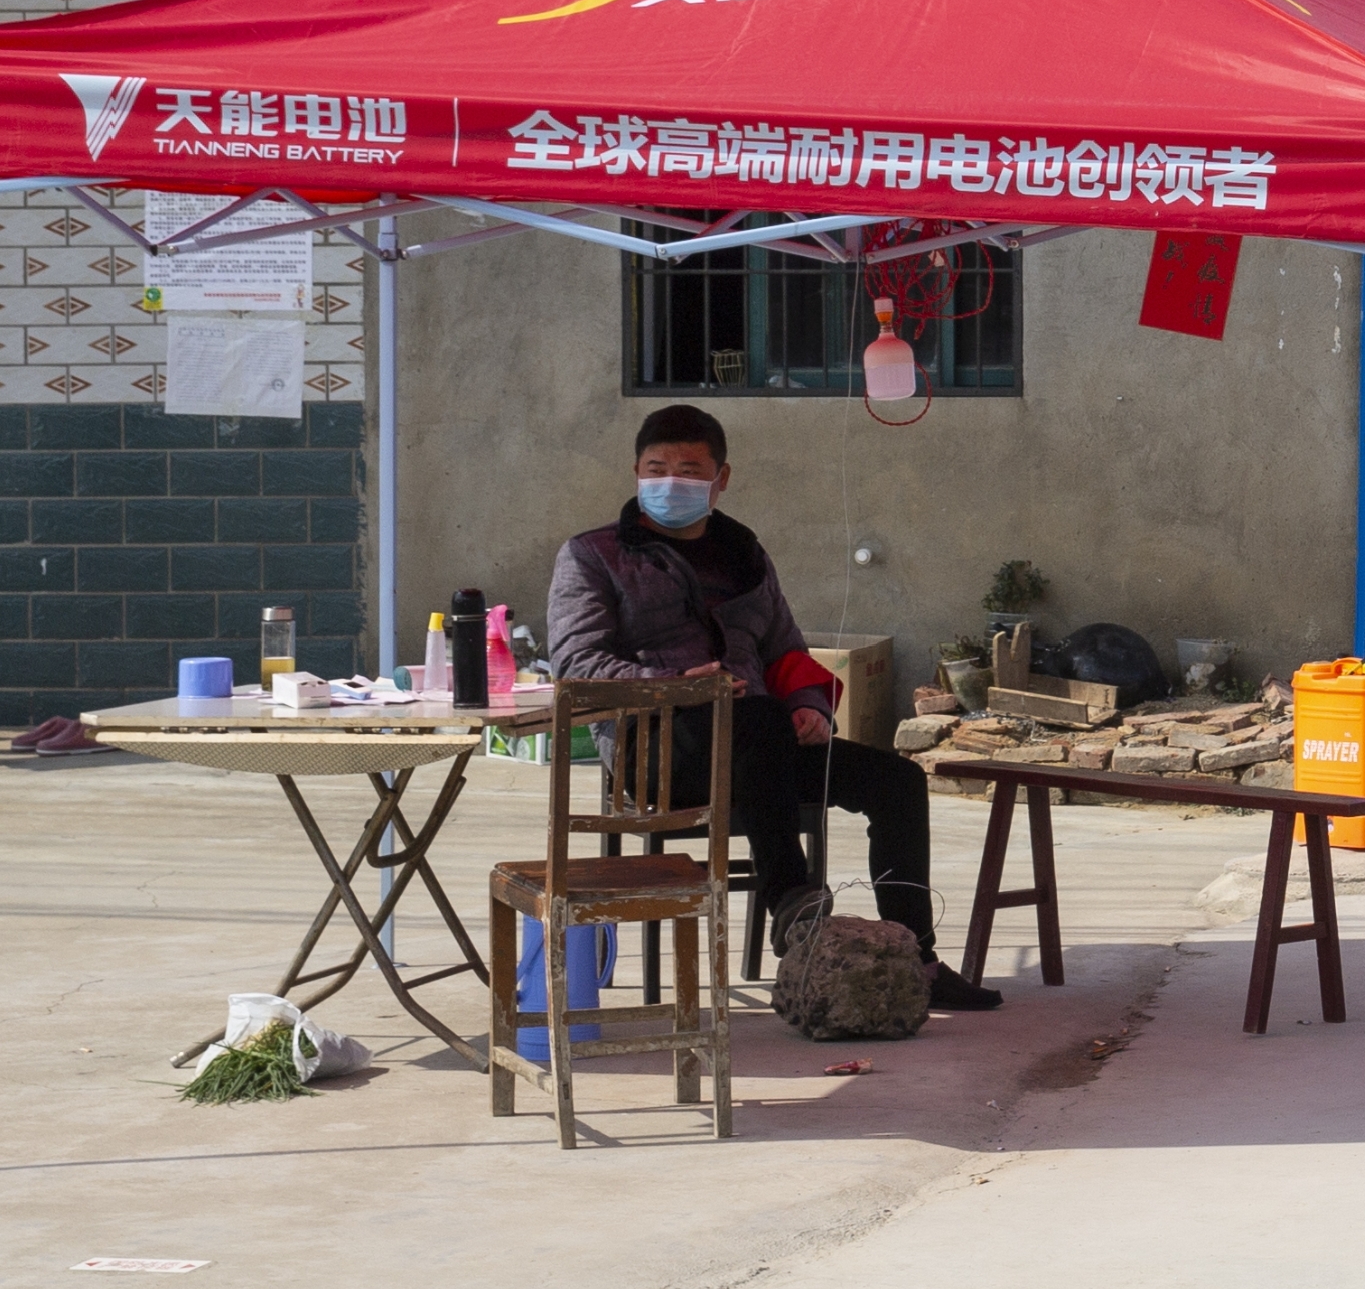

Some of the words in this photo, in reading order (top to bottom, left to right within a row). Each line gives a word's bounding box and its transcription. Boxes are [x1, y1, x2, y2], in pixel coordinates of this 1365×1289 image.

[155, 88, 407, 143] 天能电池
[153, 138, 280, 160] TIANNENG
[286, 144, 405, 164] BATTERY
[506, 109, 1277, 211] 全球高端耐用电池创领者
[1302, 738, 1360, 763] SPRAYER
